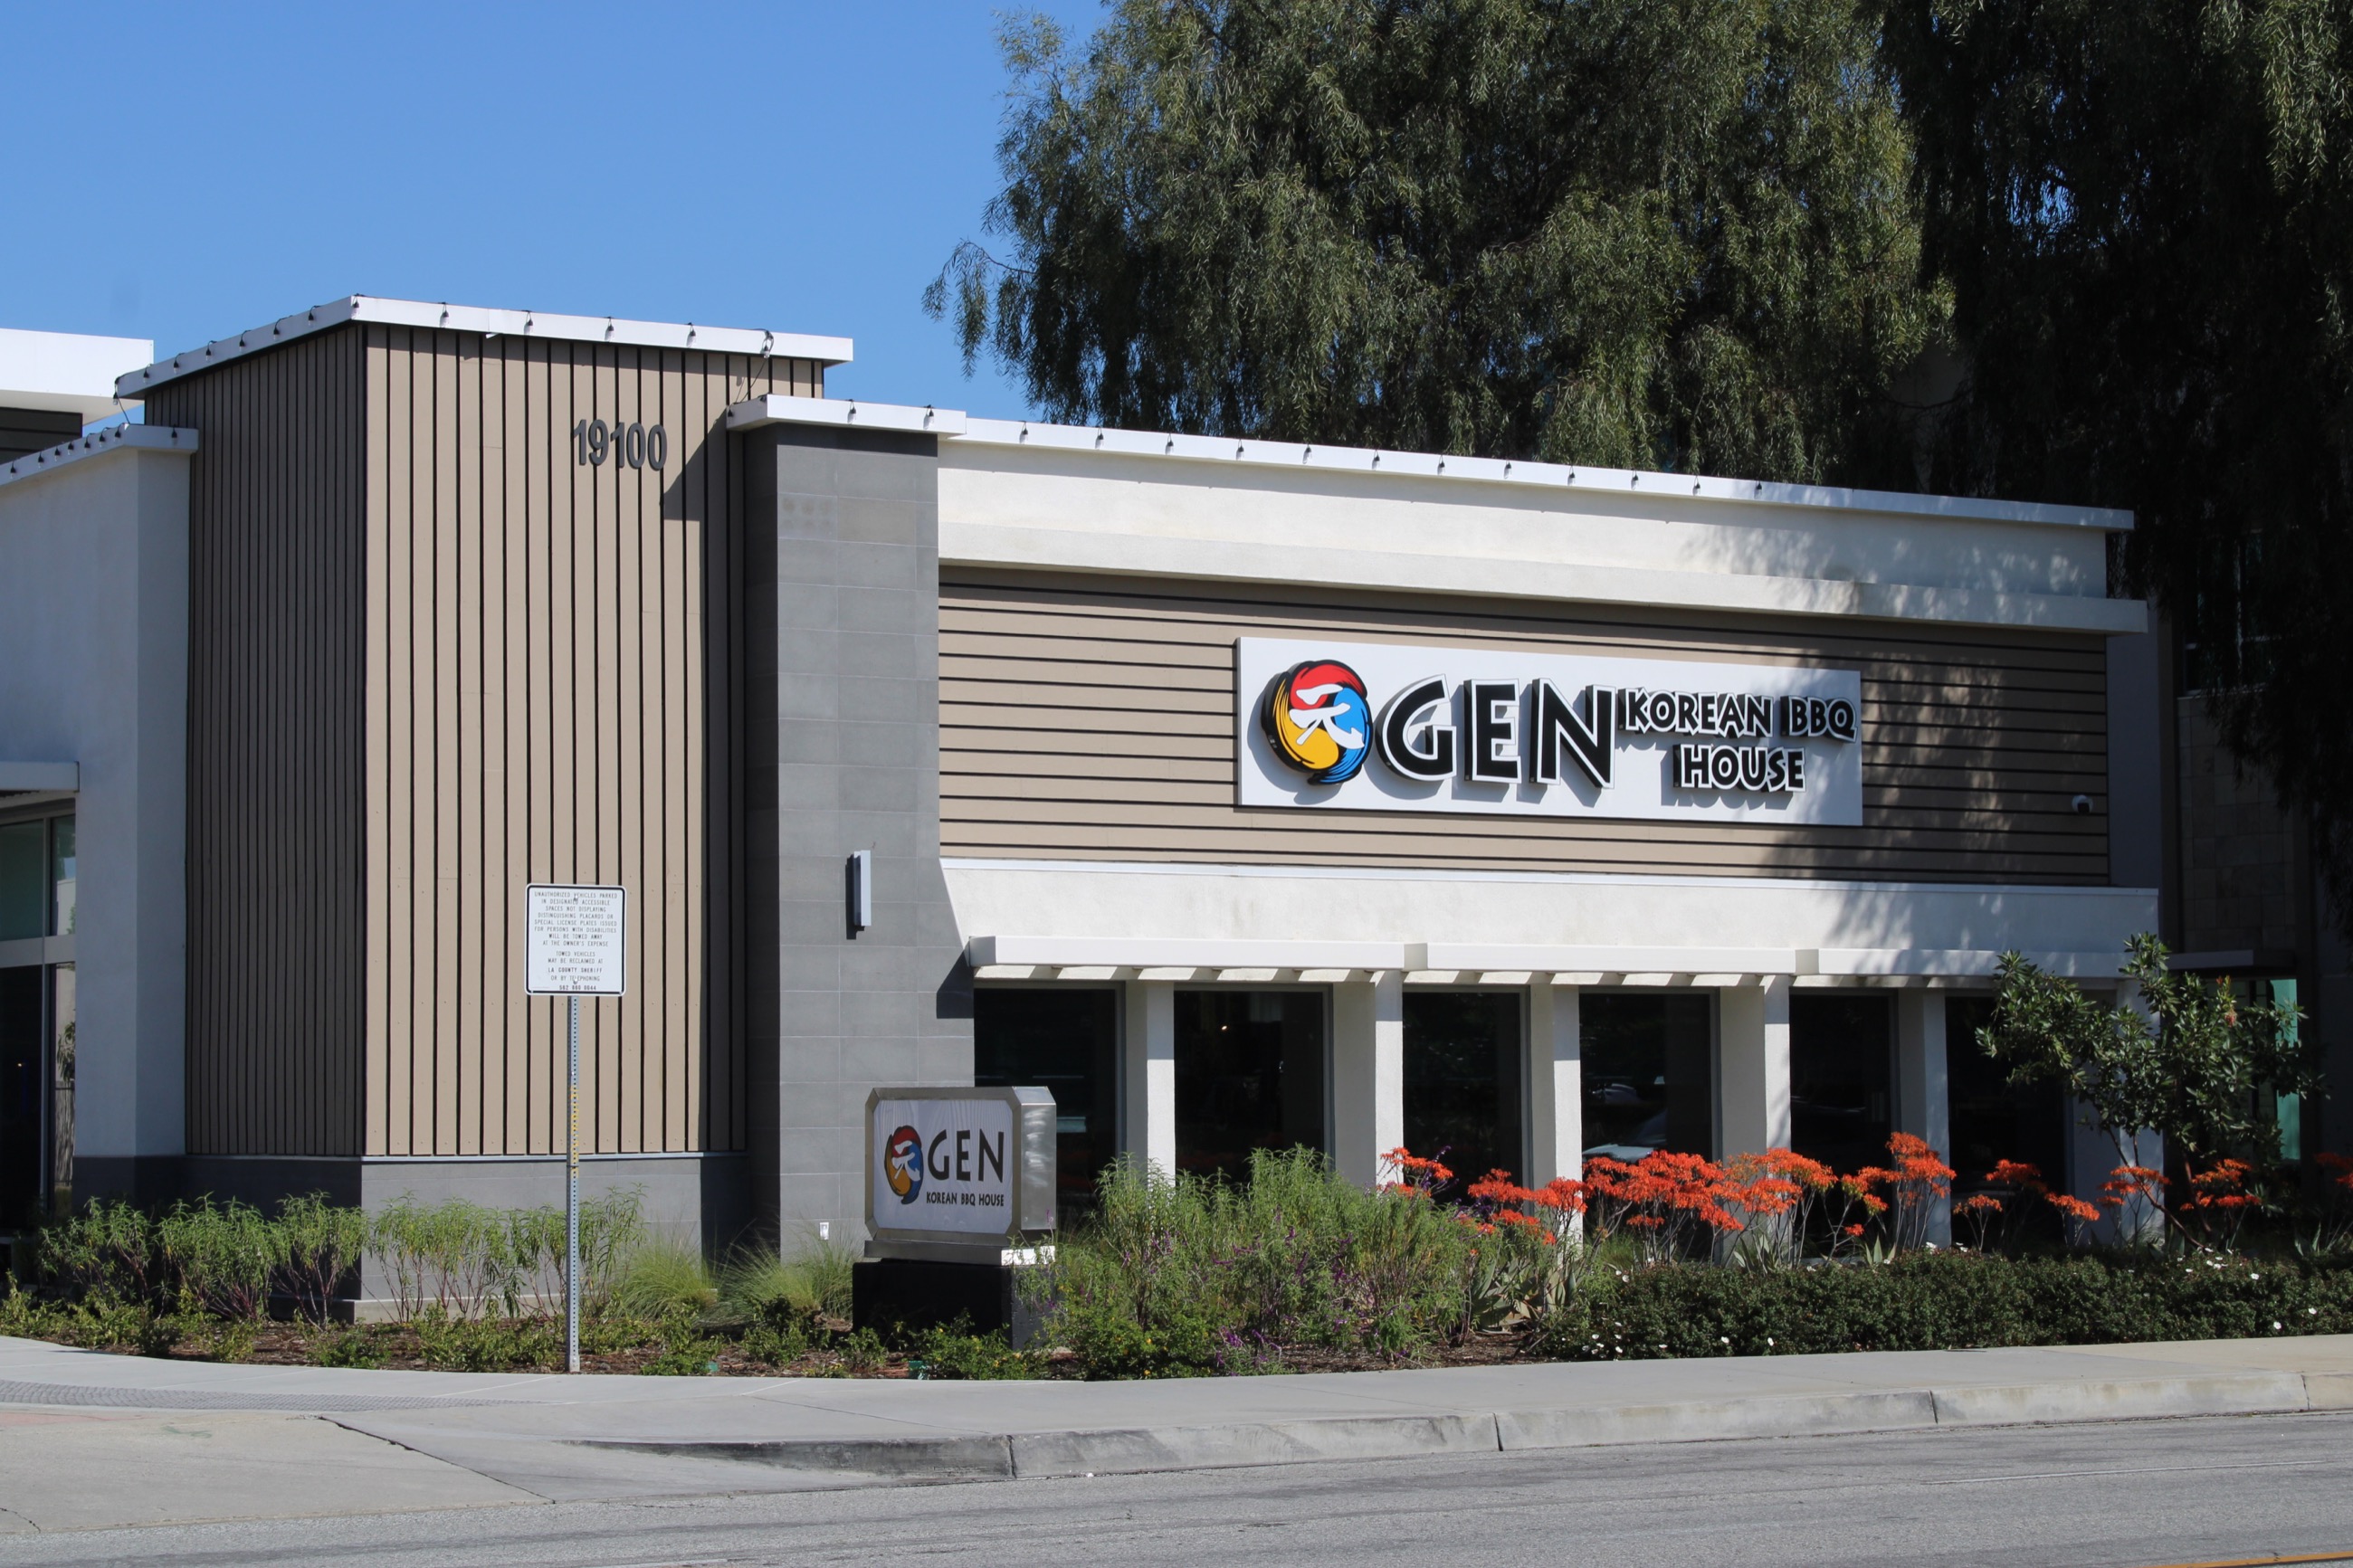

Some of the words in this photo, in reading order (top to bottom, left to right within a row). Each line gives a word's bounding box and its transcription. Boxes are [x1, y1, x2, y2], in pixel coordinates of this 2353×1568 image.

[572, 419, 667, 471] 19100
[1377, 673, 1616, 789] GEN
[1621, 687, 1775, 737] KOREAN
[1783, 695, 1858, 743] BBQ
[1675, 744, 1807, 792] HOUSE
[928, 1128, 1005, 1183] GEN
[926, 1192, 957, 1205] KOREAN
[961, 1193, 976, 1207] BBQ
[978, 1193, 1005, 1207] HOUSE
